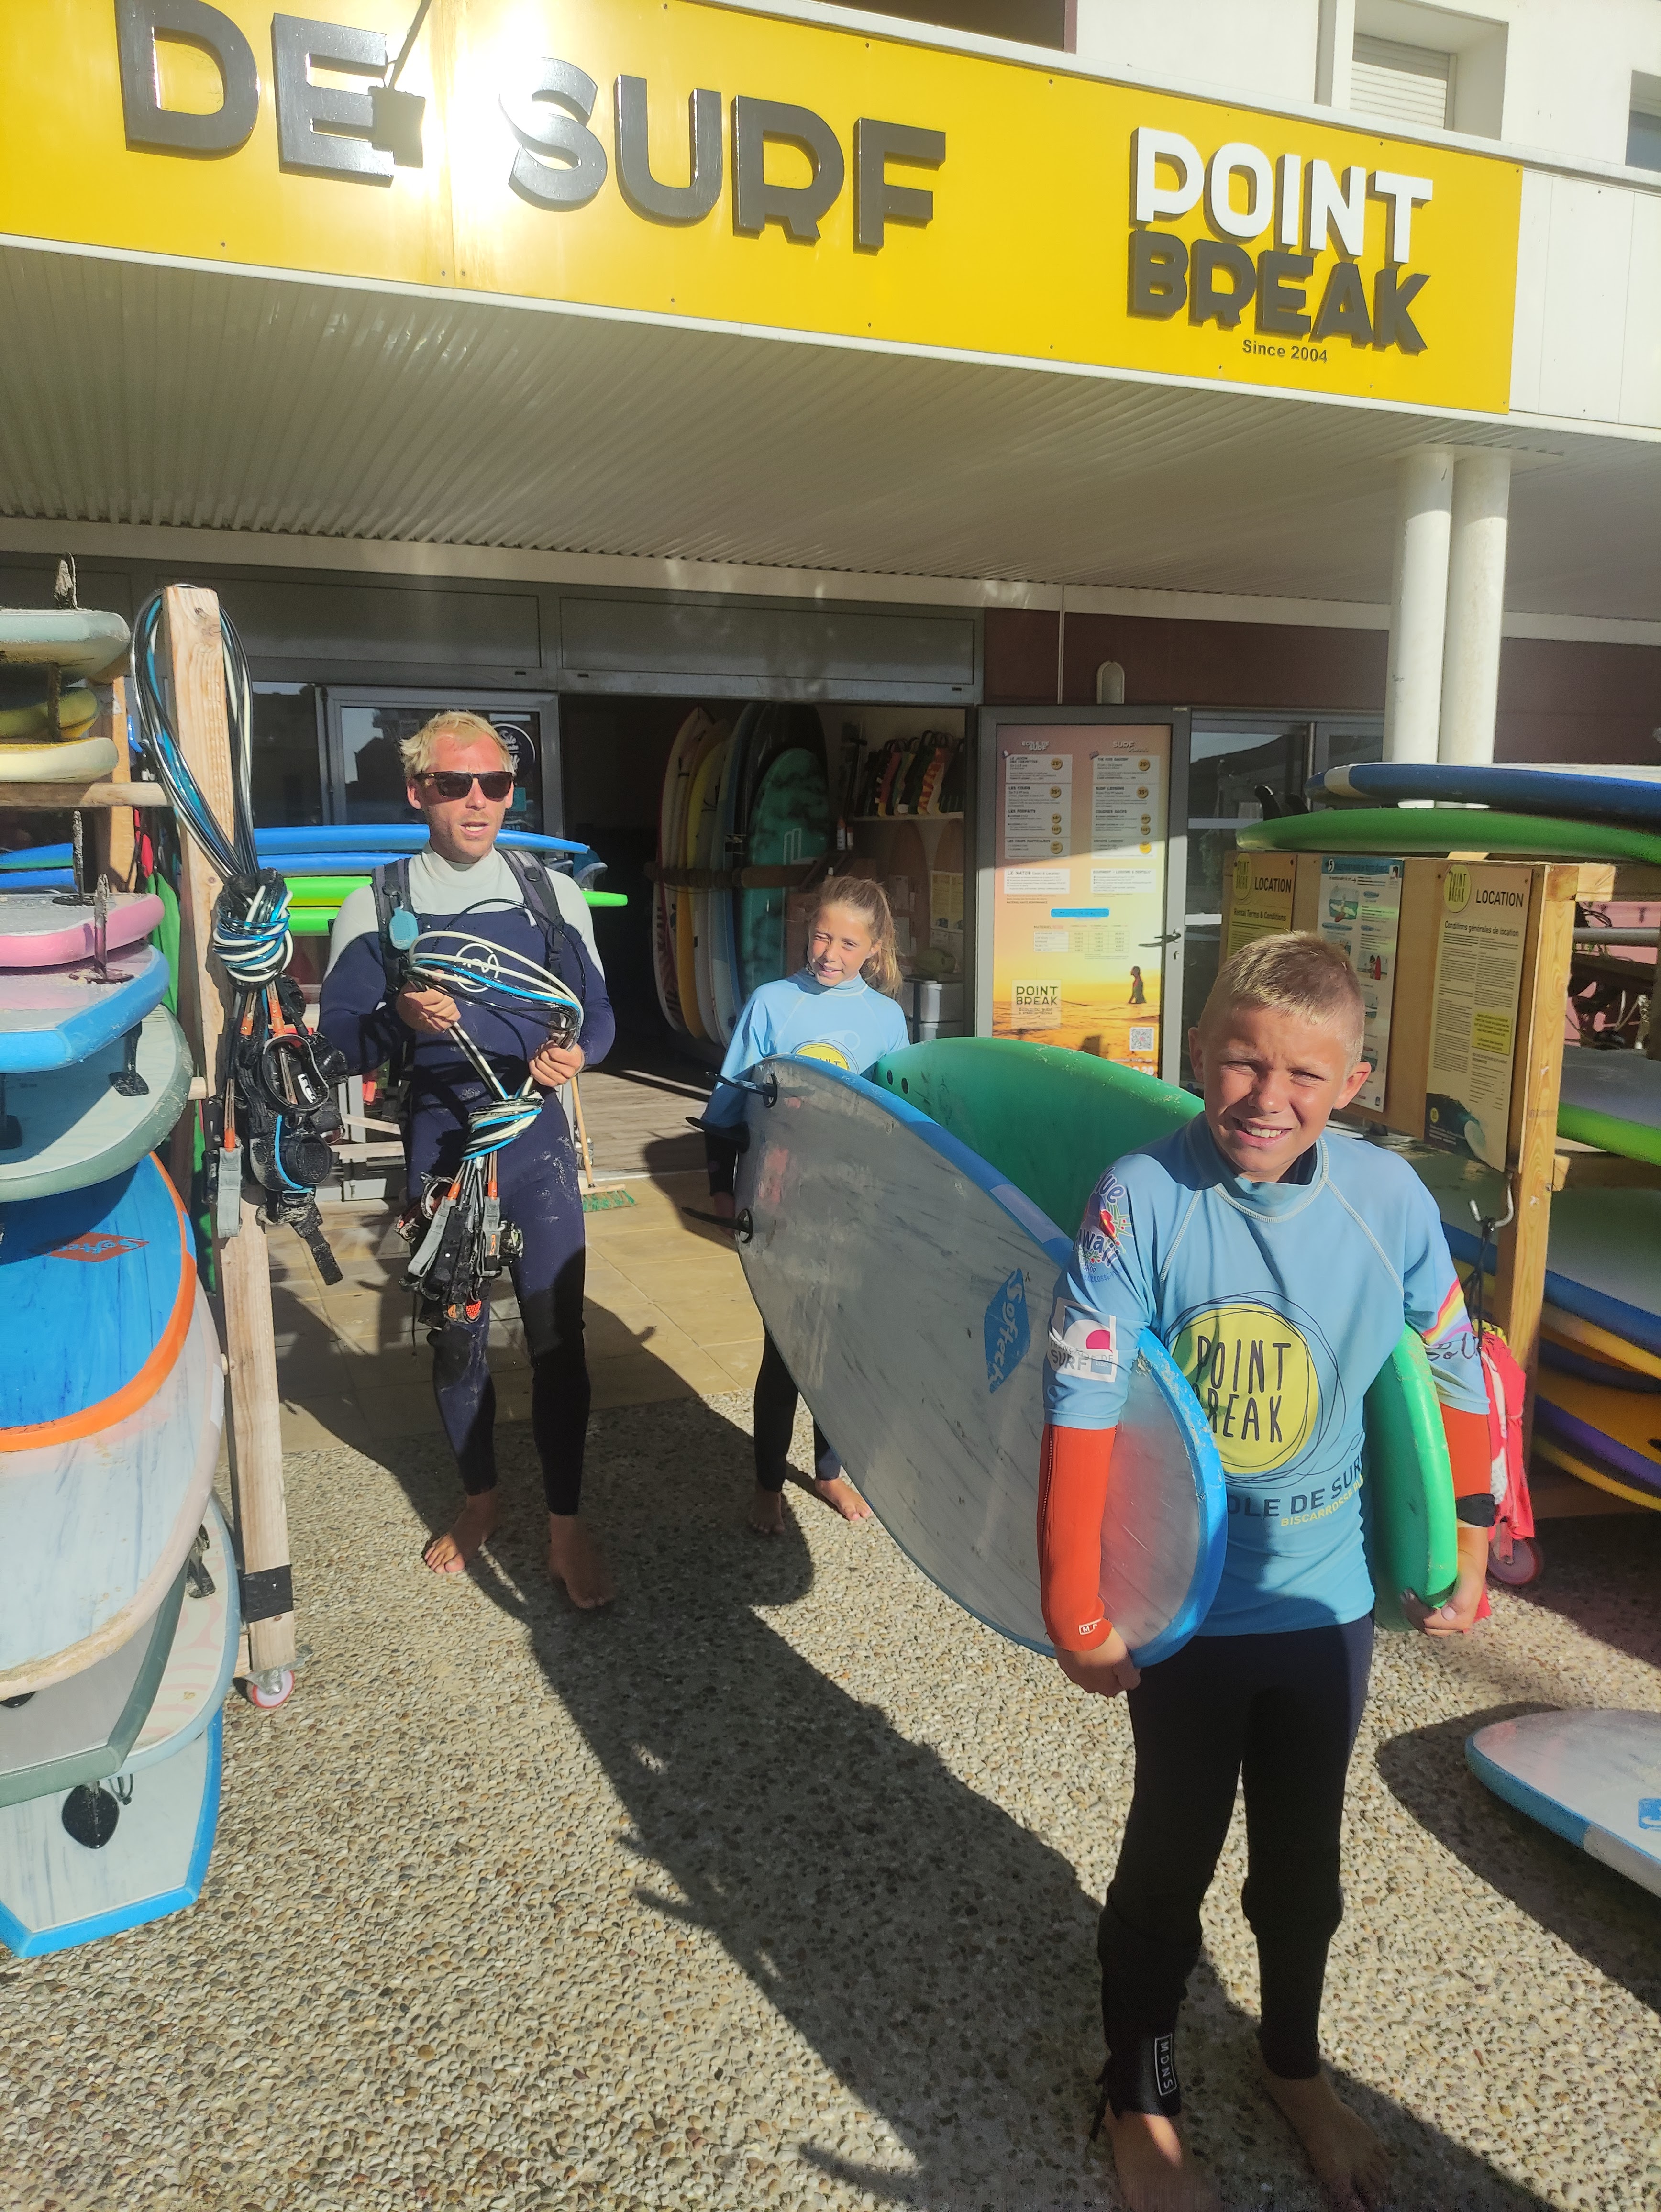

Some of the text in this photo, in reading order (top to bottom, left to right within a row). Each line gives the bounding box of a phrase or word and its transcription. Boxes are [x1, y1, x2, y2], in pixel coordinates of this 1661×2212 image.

[115, 0, 946, 256] DE SURF
[1129, 126, 1433, 268] POINT
[1127, 229, 1431, 356] BREAK
[1242, 339, 1328, 364] Since 2004
[1254, 877, 1292, 893] LOCATION
[1450, 872, 1467, 887] POINT
[1449, 887, 1465, 903] BREAK
[1476, 889, 1524, 907] LOCATION
[1445, 920, 1468, 931] Conditions
[1468, 924, 1492, 934] générales
[1499, 928, 1519, 937] location
[1016, 986, 1058, 995] POINT
[1016, 996, 1058, 1005] BREAK
[1083, 1264, 1096, 1274] SHOP
[1051, 1349, 1089, 1371] SURF
[1196, 1335, 1291, 1394] POINT
[1281, 1487, 1353, 1527] BISCARROSSE
[1290, 1488, 1325, 1515] DE
[1160, 2041, 1173, 2089] MDNS
